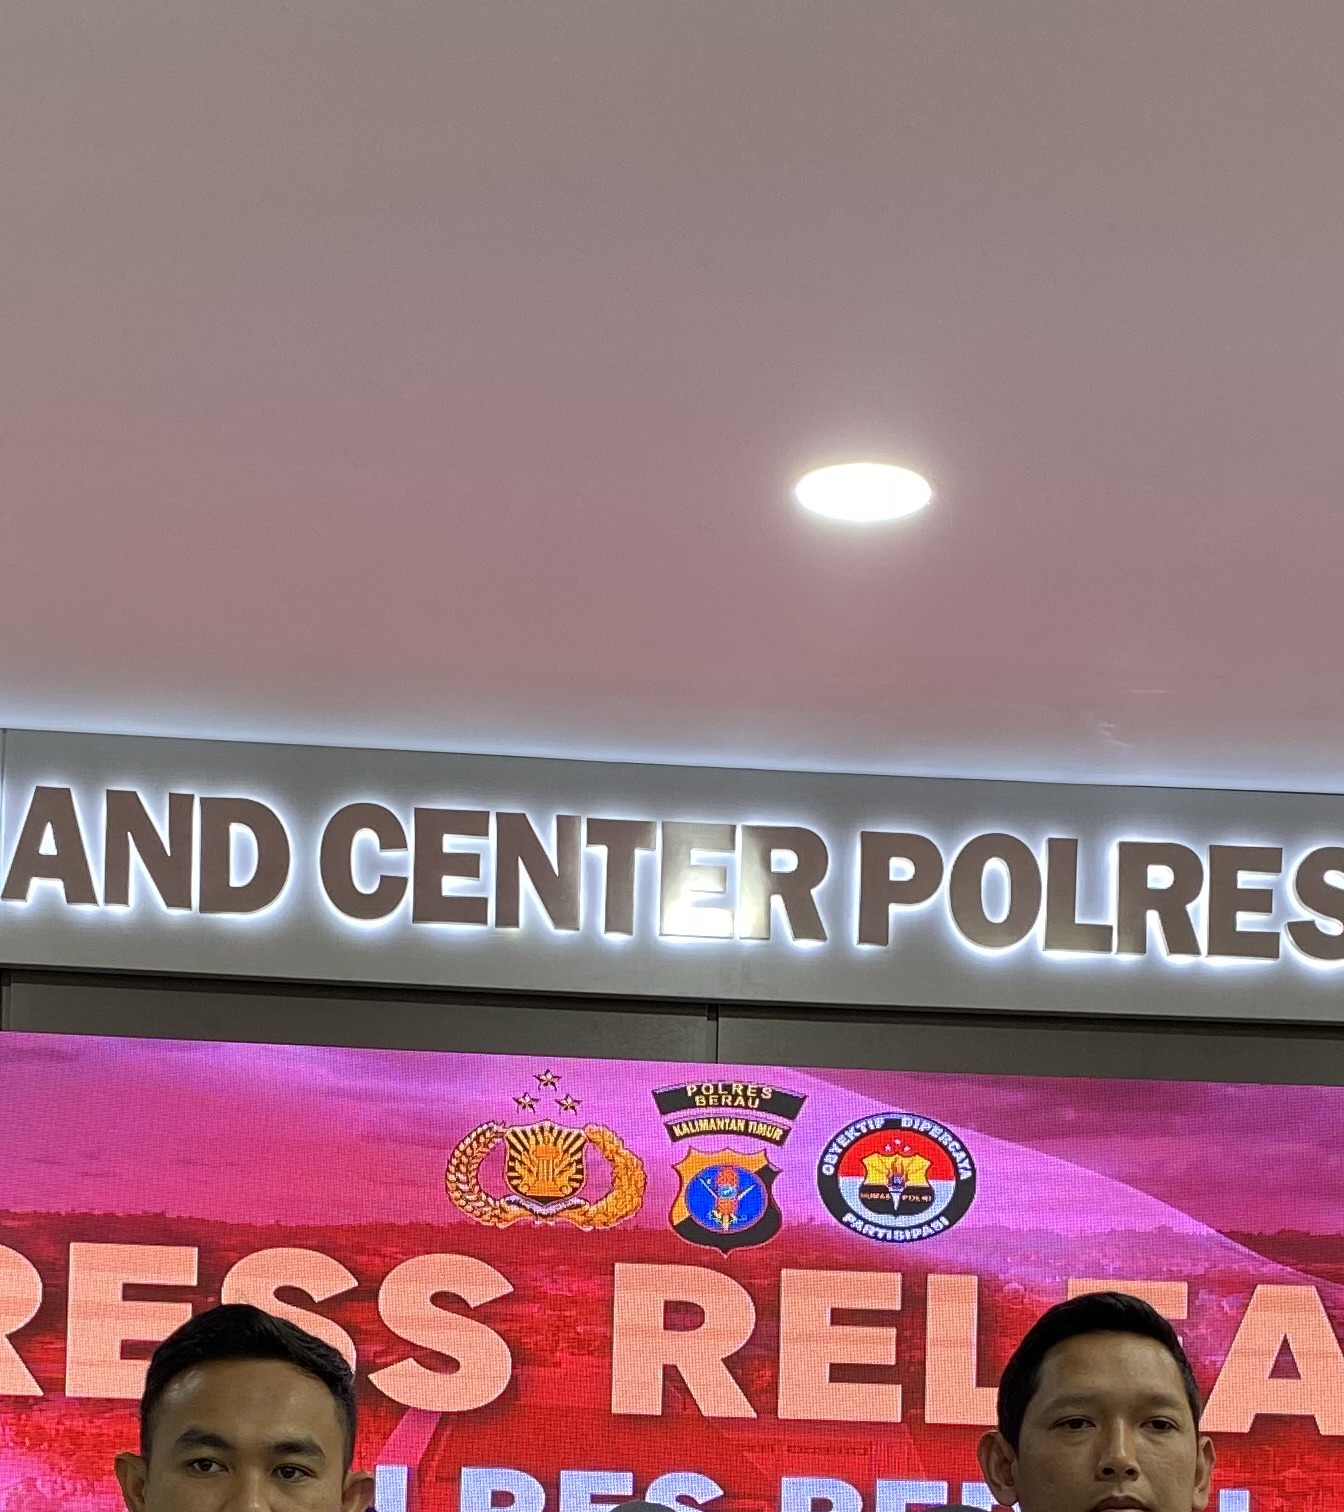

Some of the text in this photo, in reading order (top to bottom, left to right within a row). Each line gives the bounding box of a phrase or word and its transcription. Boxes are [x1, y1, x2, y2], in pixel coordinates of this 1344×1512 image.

[319, 802, 829, 942] CENTER
[686, 1082, 773, 1099] POLRES
[695, 1095, 760, 1109] BERAU
[672, 1117, 784, 1141] KALIMANTAN TIMUR
[822, 1117, 973, 1180] OBYEKTIF DIPERCAYA
